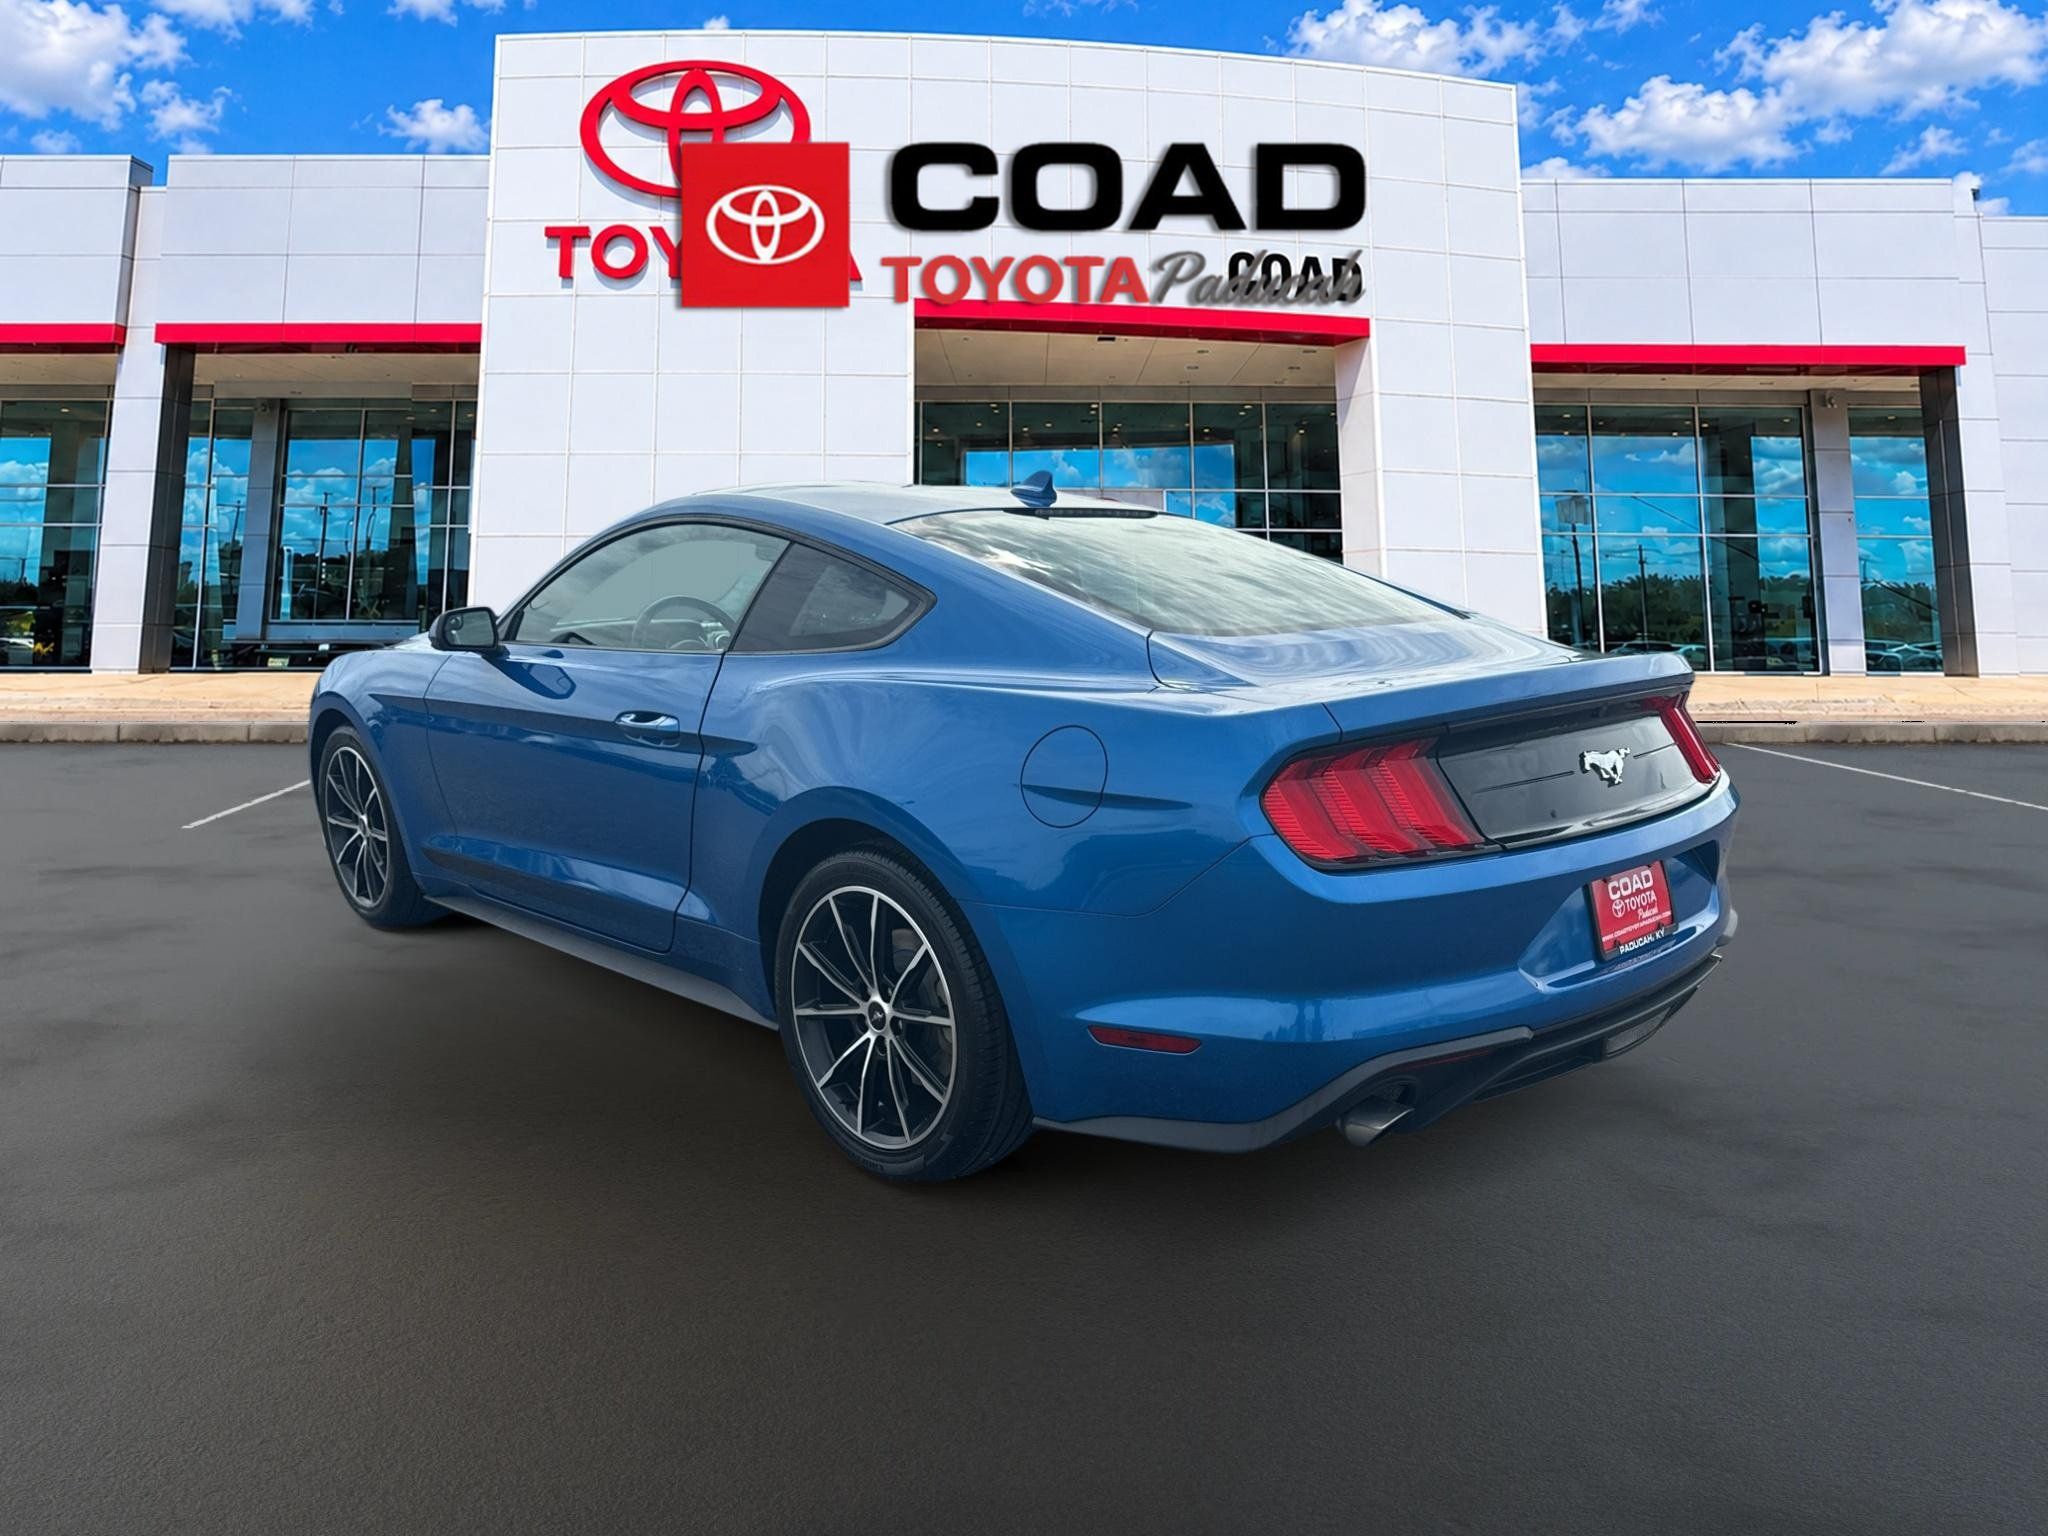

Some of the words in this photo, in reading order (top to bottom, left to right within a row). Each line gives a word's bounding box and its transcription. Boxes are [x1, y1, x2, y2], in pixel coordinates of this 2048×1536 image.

[1228, 251, 1363, 301] COAD
[1607, 869, 1654, 900] COAD
[1624, 890, 1657, 911] TOYOTA
[1655, 927, 1665, 939] KY
